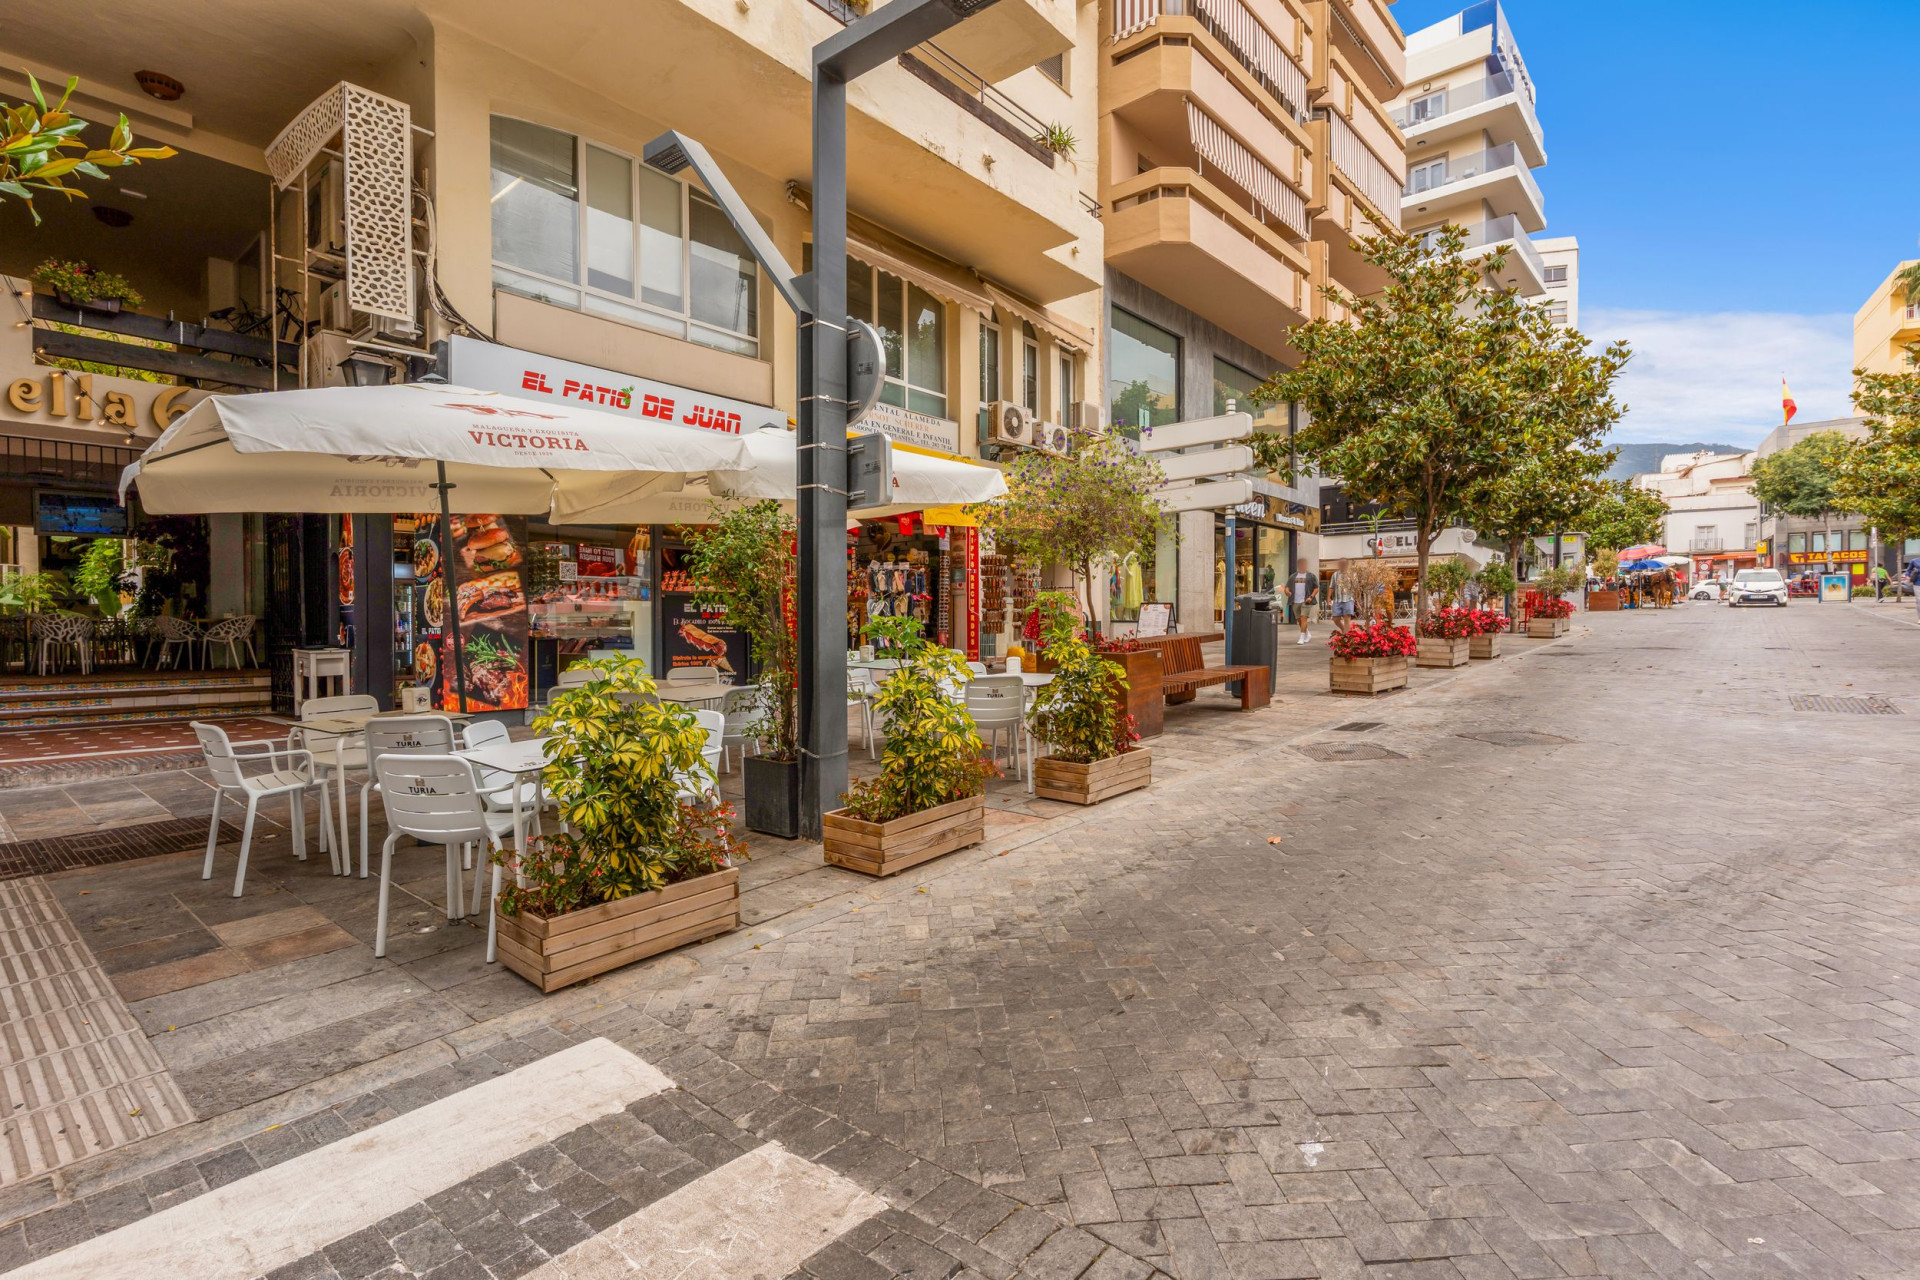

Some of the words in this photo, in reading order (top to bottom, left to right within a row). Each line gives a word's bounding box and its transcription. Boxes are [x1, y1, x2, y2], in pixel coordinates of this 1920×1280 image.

[522, 371, 553, 394] EL
[562, 379, 631, 410] PATIO
[641, 394, 675, 421] DE
[682, 405, 742, 434] JUAN
[874, 405, 900, 416] ENTAL
[904, 412, 941, 426] ALAMEDA
[468, 430, 590, 451] VICTORIA
[473, 424, 526, 433] MALAGUEÑA
[536, 429, 579, 437] EXQUISITA
[871, 420, 881, 428] EN
[883, 423, 915, 437] GENERAL
[923, 431, 952, 445] INFANTIL
[684, 603, 697, 612] EL
[408, 786, 436, 794] TURIA
